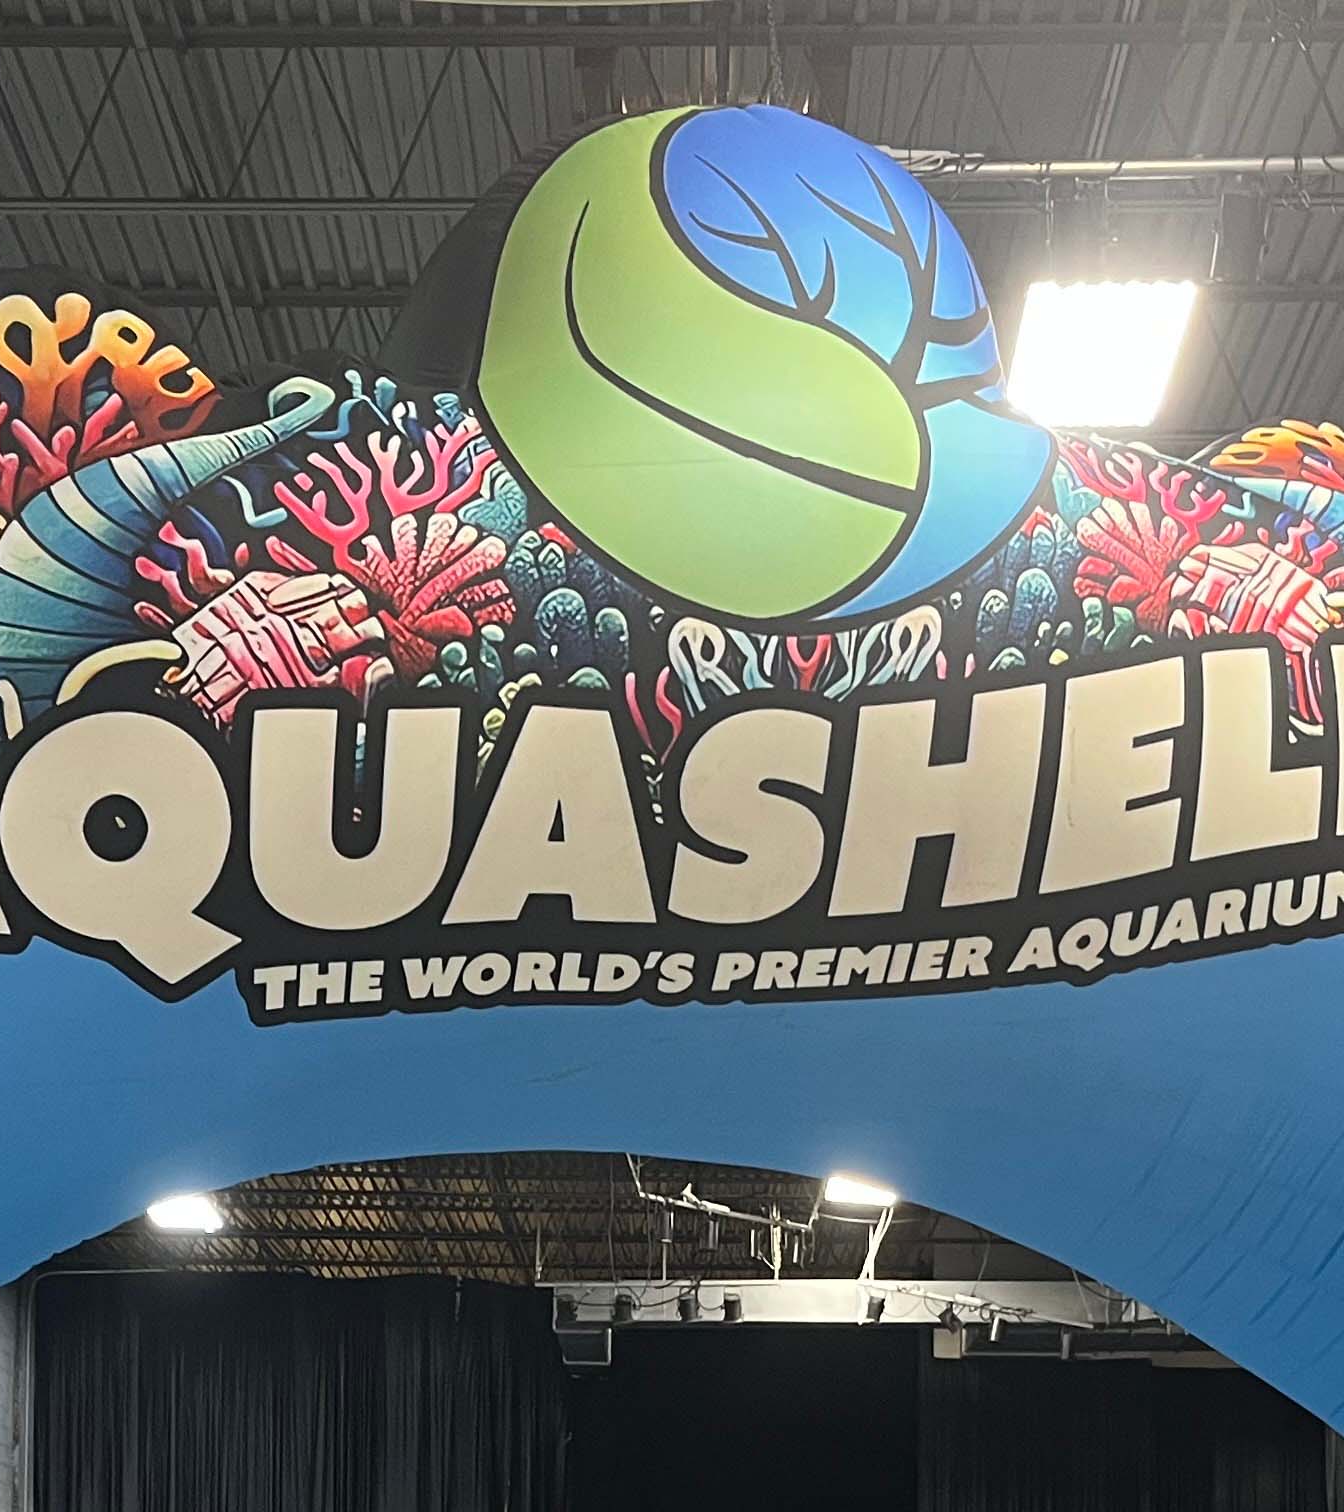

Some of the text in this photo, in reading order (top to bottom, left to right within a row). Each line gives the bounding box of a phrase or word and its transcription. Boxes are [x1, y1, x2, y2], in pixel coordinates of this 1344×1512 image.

[254, 961, 383, 1011] THE
[402, 949, 695, 1000] WORLD'S
[711, 936, 993, 993] PREMIER
